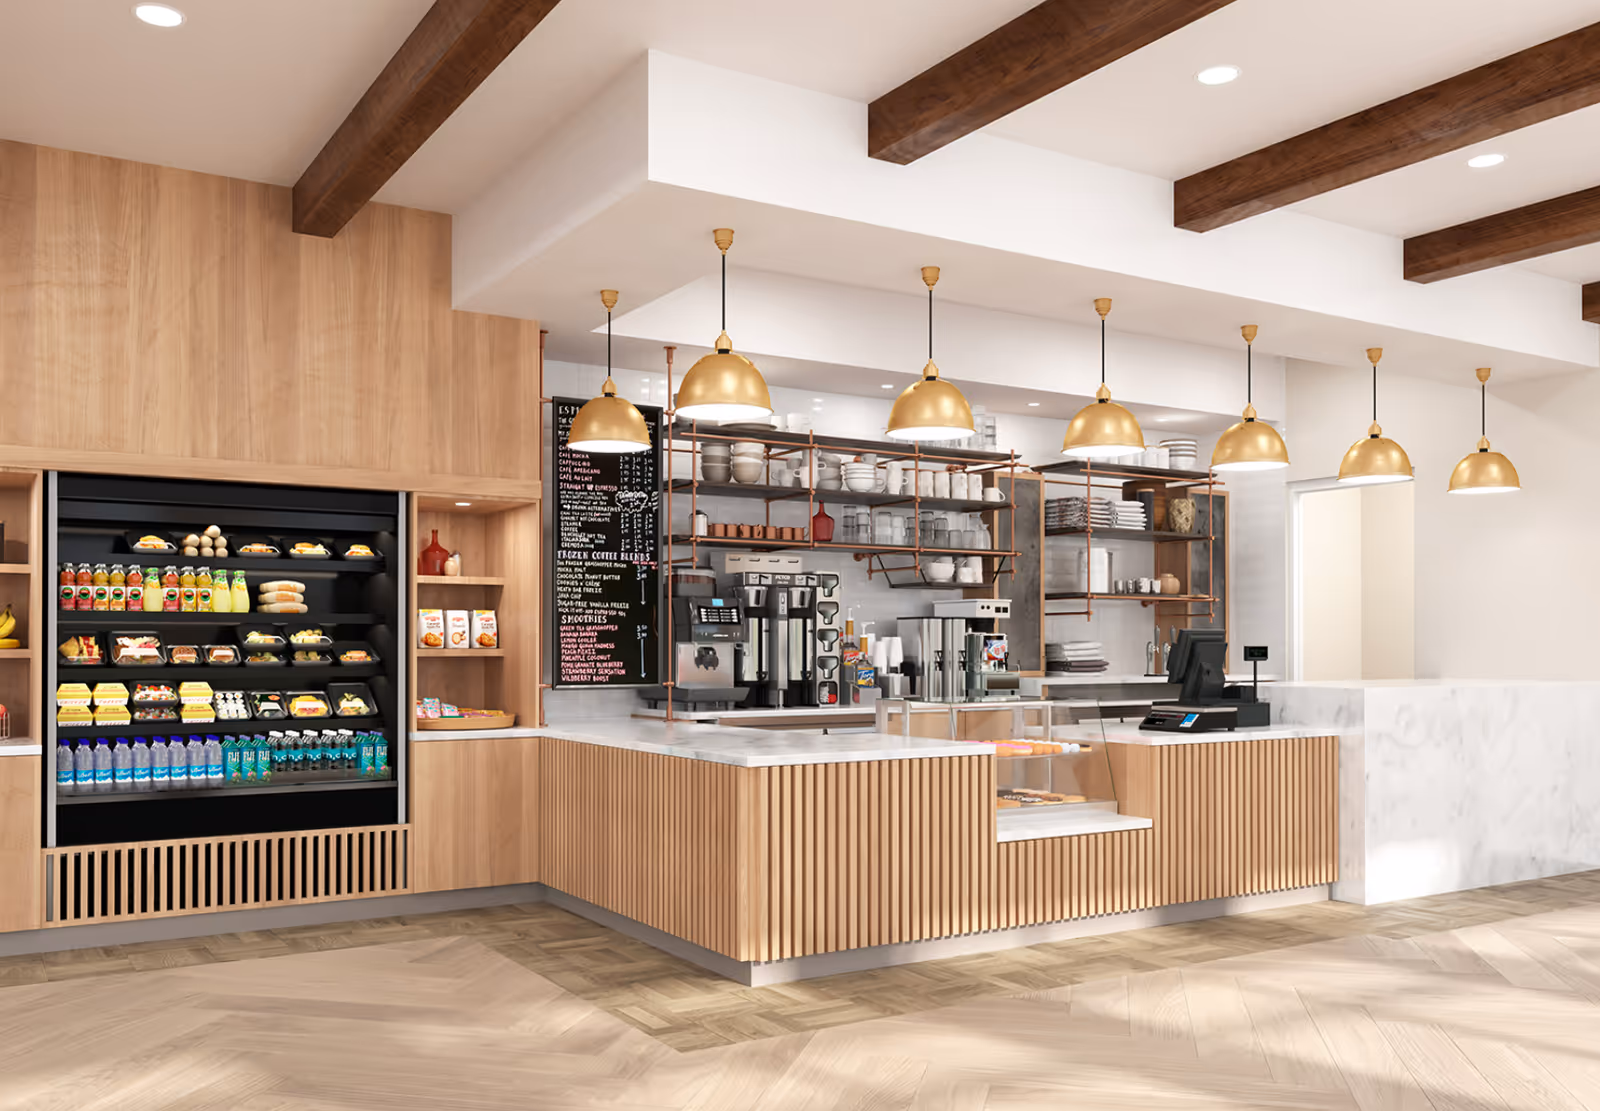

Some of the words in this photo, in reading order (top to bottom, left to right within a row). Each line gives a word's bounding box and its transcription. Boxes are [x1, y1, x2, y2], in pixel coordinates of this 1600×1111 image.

[573, 467, 601, 475] AMERICANO
[595, 484, 618, 492] ESPRESSO
[557, 550, 589, 560] FROZEN
[591, 551, 618, 560] COFFEE
[620, 552, 651, 561] BLENDS
[561, 615, 608, 624] SMOOTHIES
[561, 661, 595, 669] POMEGRANATE
[228, 751, 239, 761] FIJI
[243, 750, 255, 761] FIJI
[258, 750, 270, 761] FIJI
